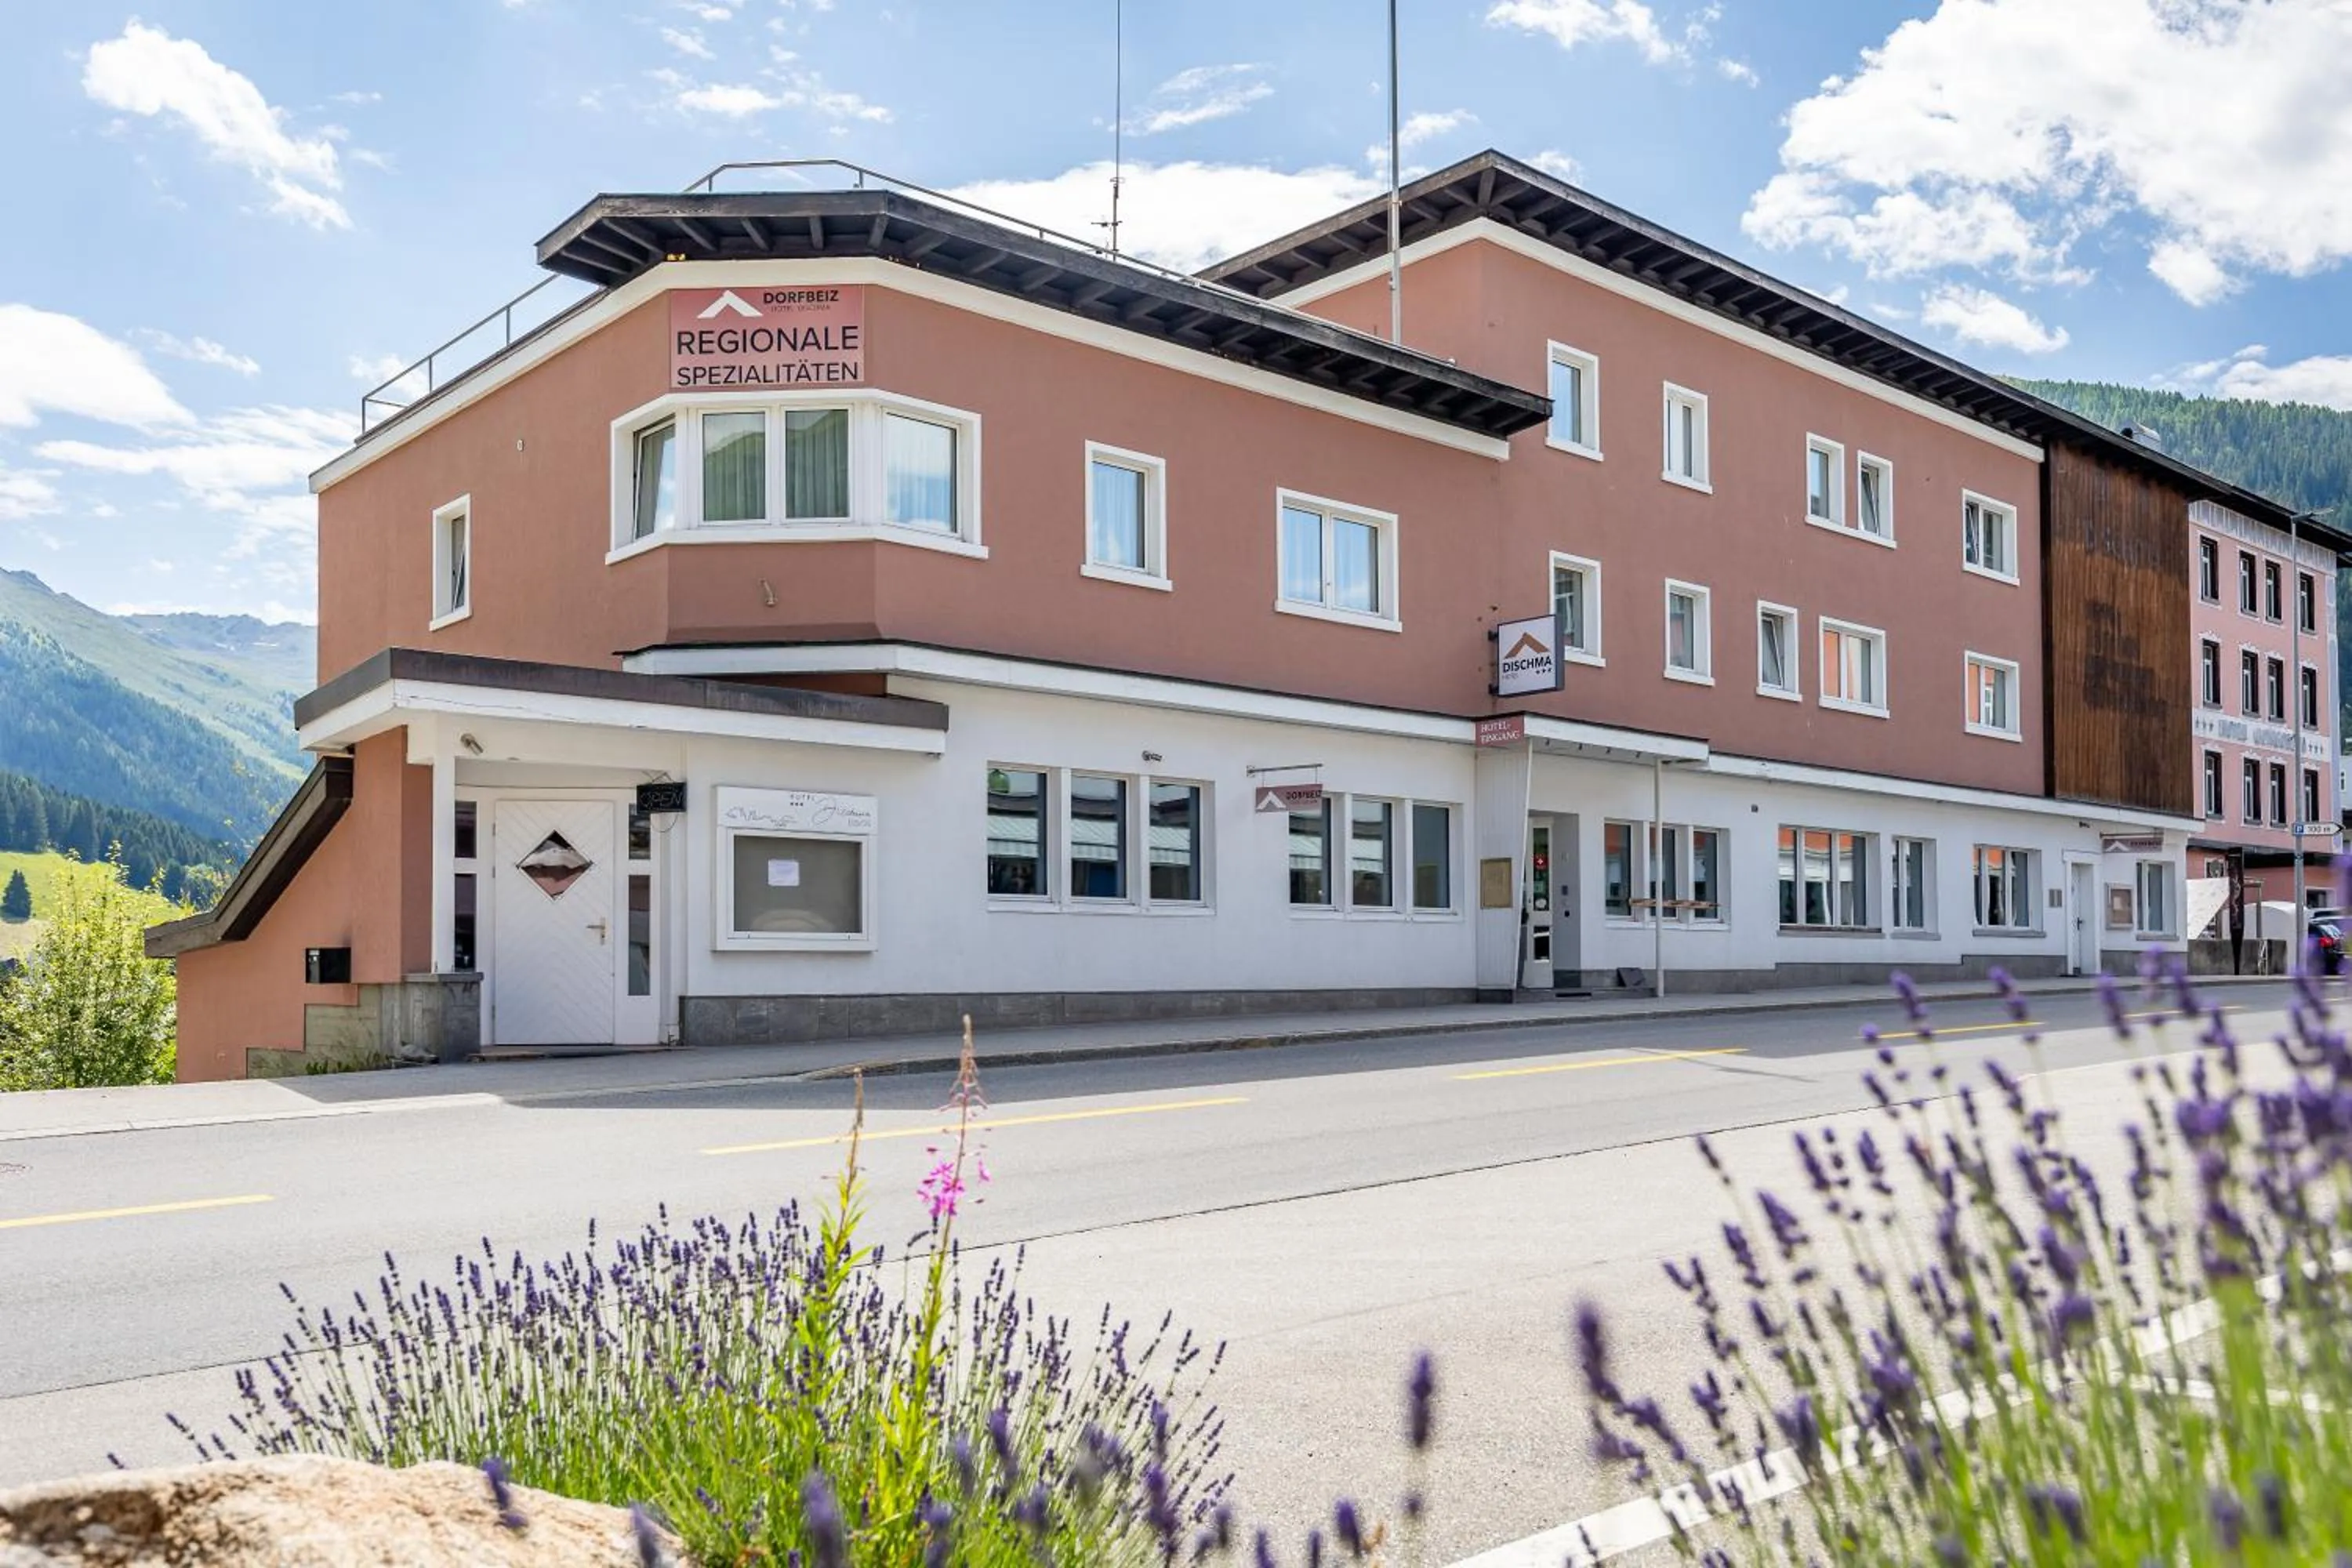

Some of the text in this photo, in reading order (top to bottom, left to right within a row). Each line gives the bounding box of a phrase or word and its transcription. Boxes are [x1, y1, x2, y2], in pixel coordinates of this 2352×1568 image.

[763, 289, 839, 305] DORFBEIZ
[677, 325, 859, 354] REGIONALE
[677, 358, 858, 387] SPEZIALITÄTEN
[1502, 655, 1553, 673] DISCHMA
